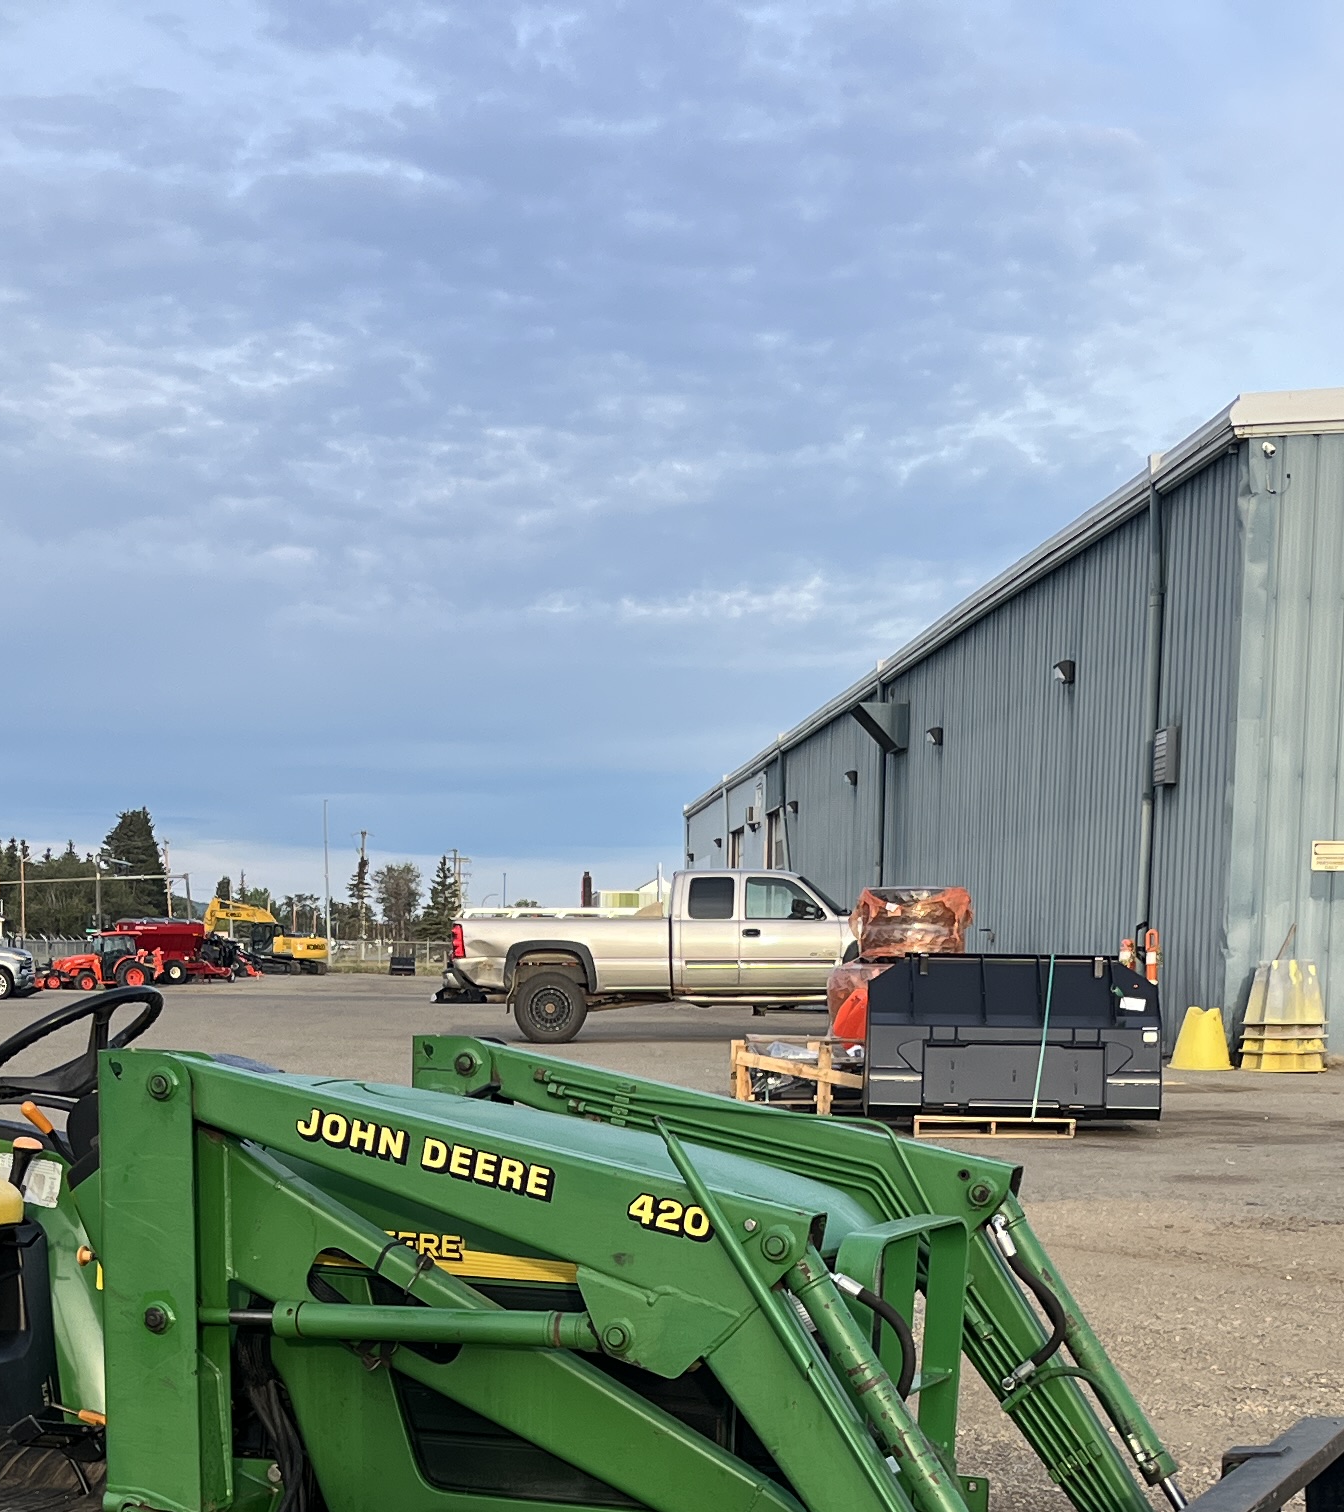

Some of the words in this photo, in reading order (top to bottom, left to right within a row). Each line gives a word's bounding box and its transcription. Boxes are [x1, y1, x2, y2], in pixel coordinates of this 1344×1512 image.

[296, 1108, 408, 1163] JOHN
[421, 1137, 554, 1200] DEERE
[627, 1192, 712, 1241] 420
